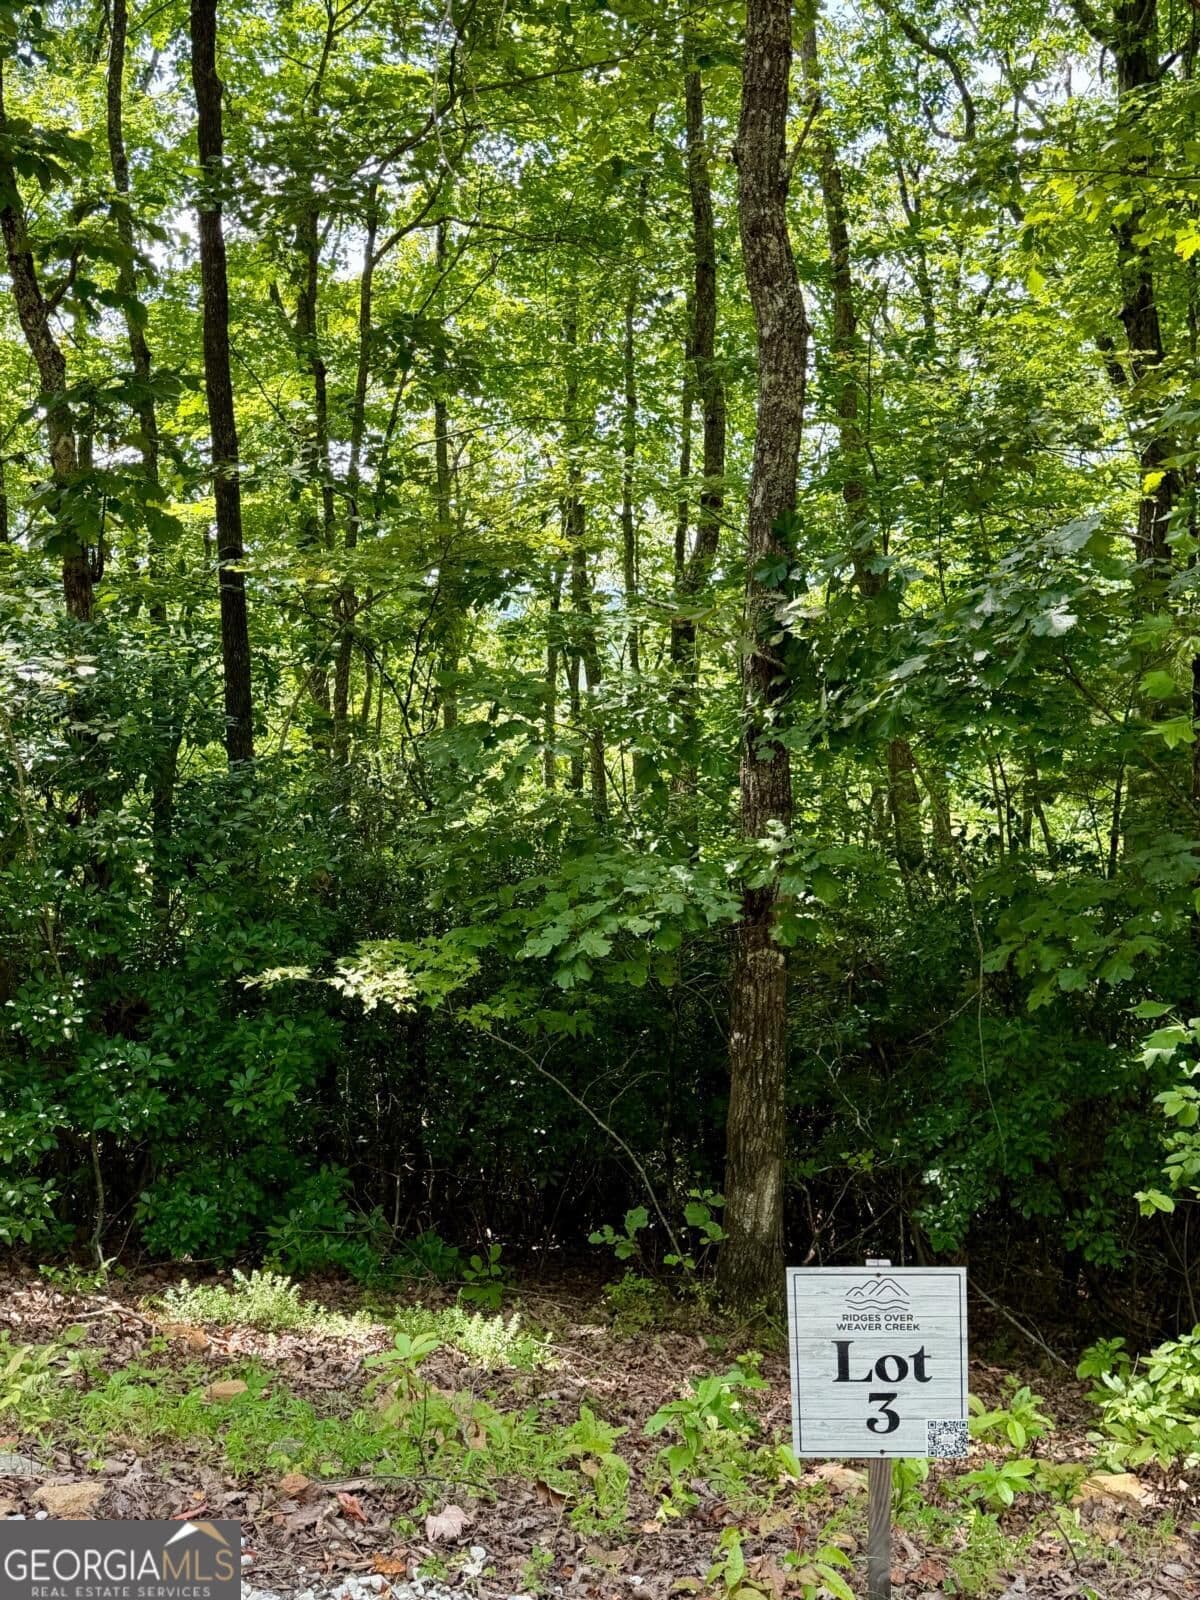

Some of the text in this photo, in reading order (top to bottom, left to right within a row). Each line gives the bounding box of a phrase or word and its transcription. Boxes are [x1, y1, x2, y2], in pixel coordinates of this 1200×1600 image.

[835, 1322, 920, 1331] WEAVER CREEK
[841, 1313, 914, 1322] RIDGES OVER
[831, 1340, 933, 1383] Lot
[866, 1392, 900, 1434] 3
